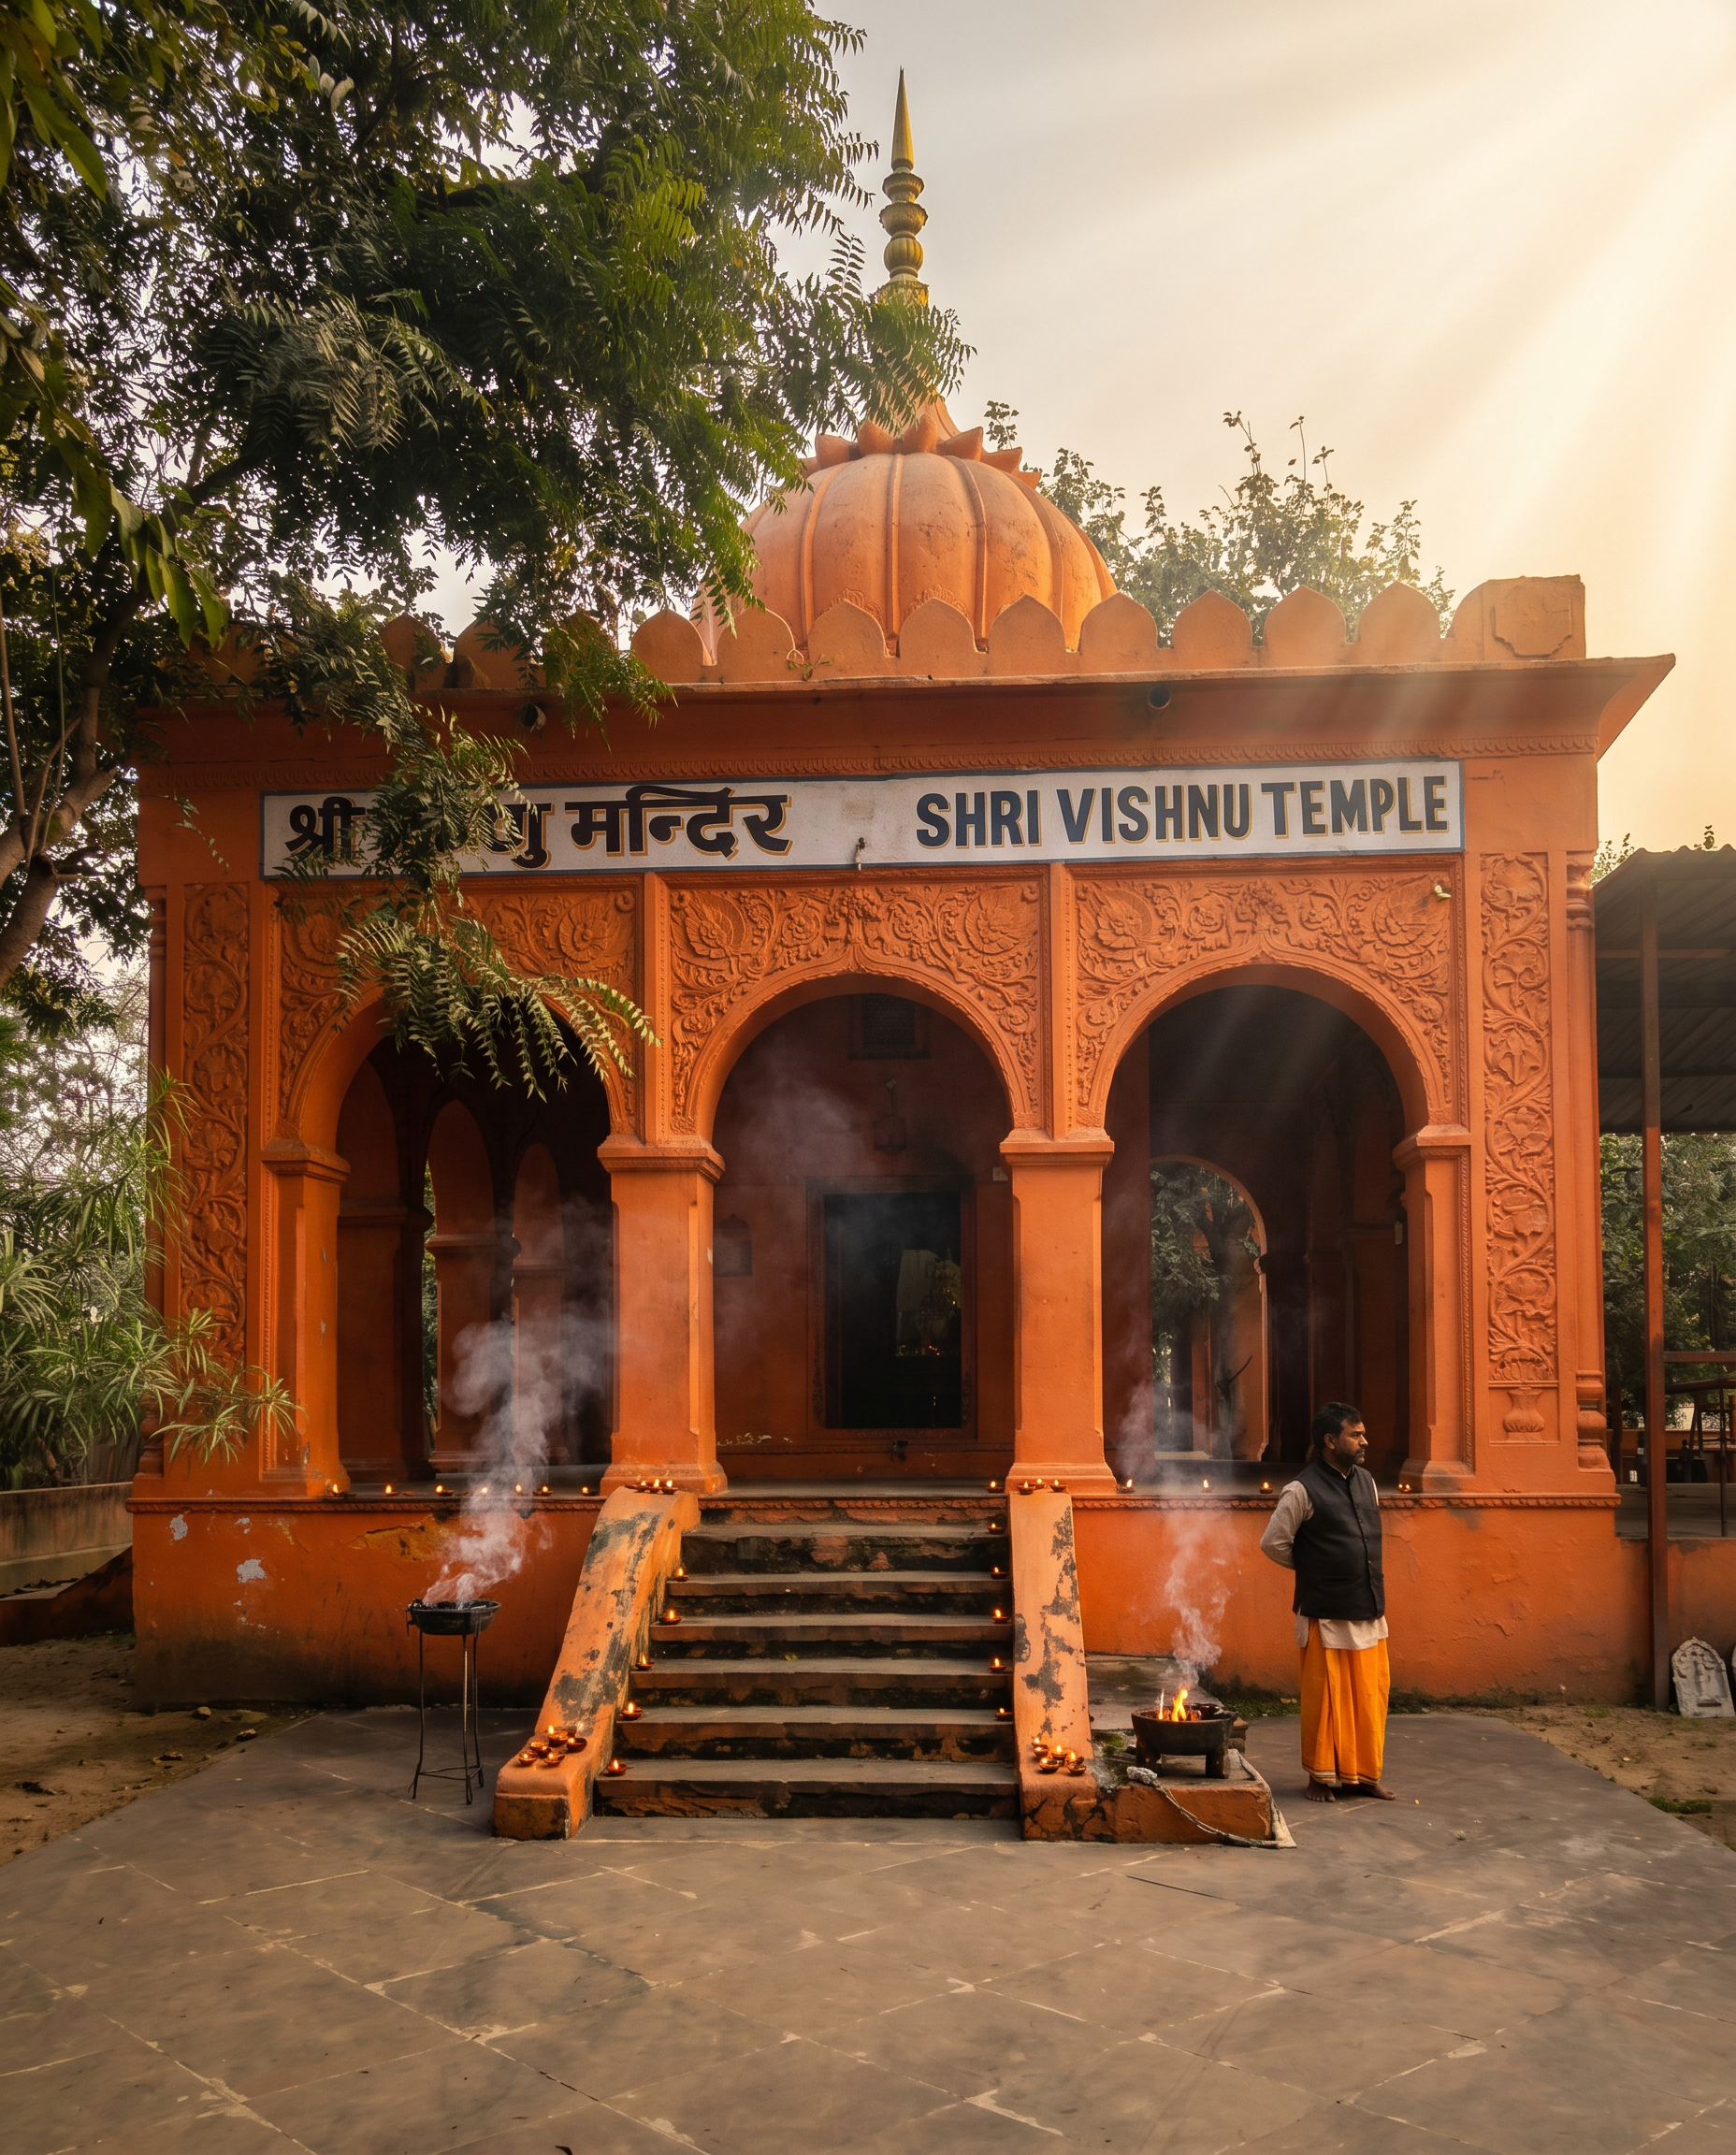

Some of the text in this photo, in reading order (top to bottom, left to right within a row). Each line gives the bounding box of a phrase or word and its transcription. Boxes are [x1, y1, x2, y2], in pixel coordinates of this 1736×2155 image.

[284, 796, 366, 861] श्री
[565, 786, 791, 861] मन्दिर
[916, 775, 1449, 849] SHRI VISHNU TEMPLE
